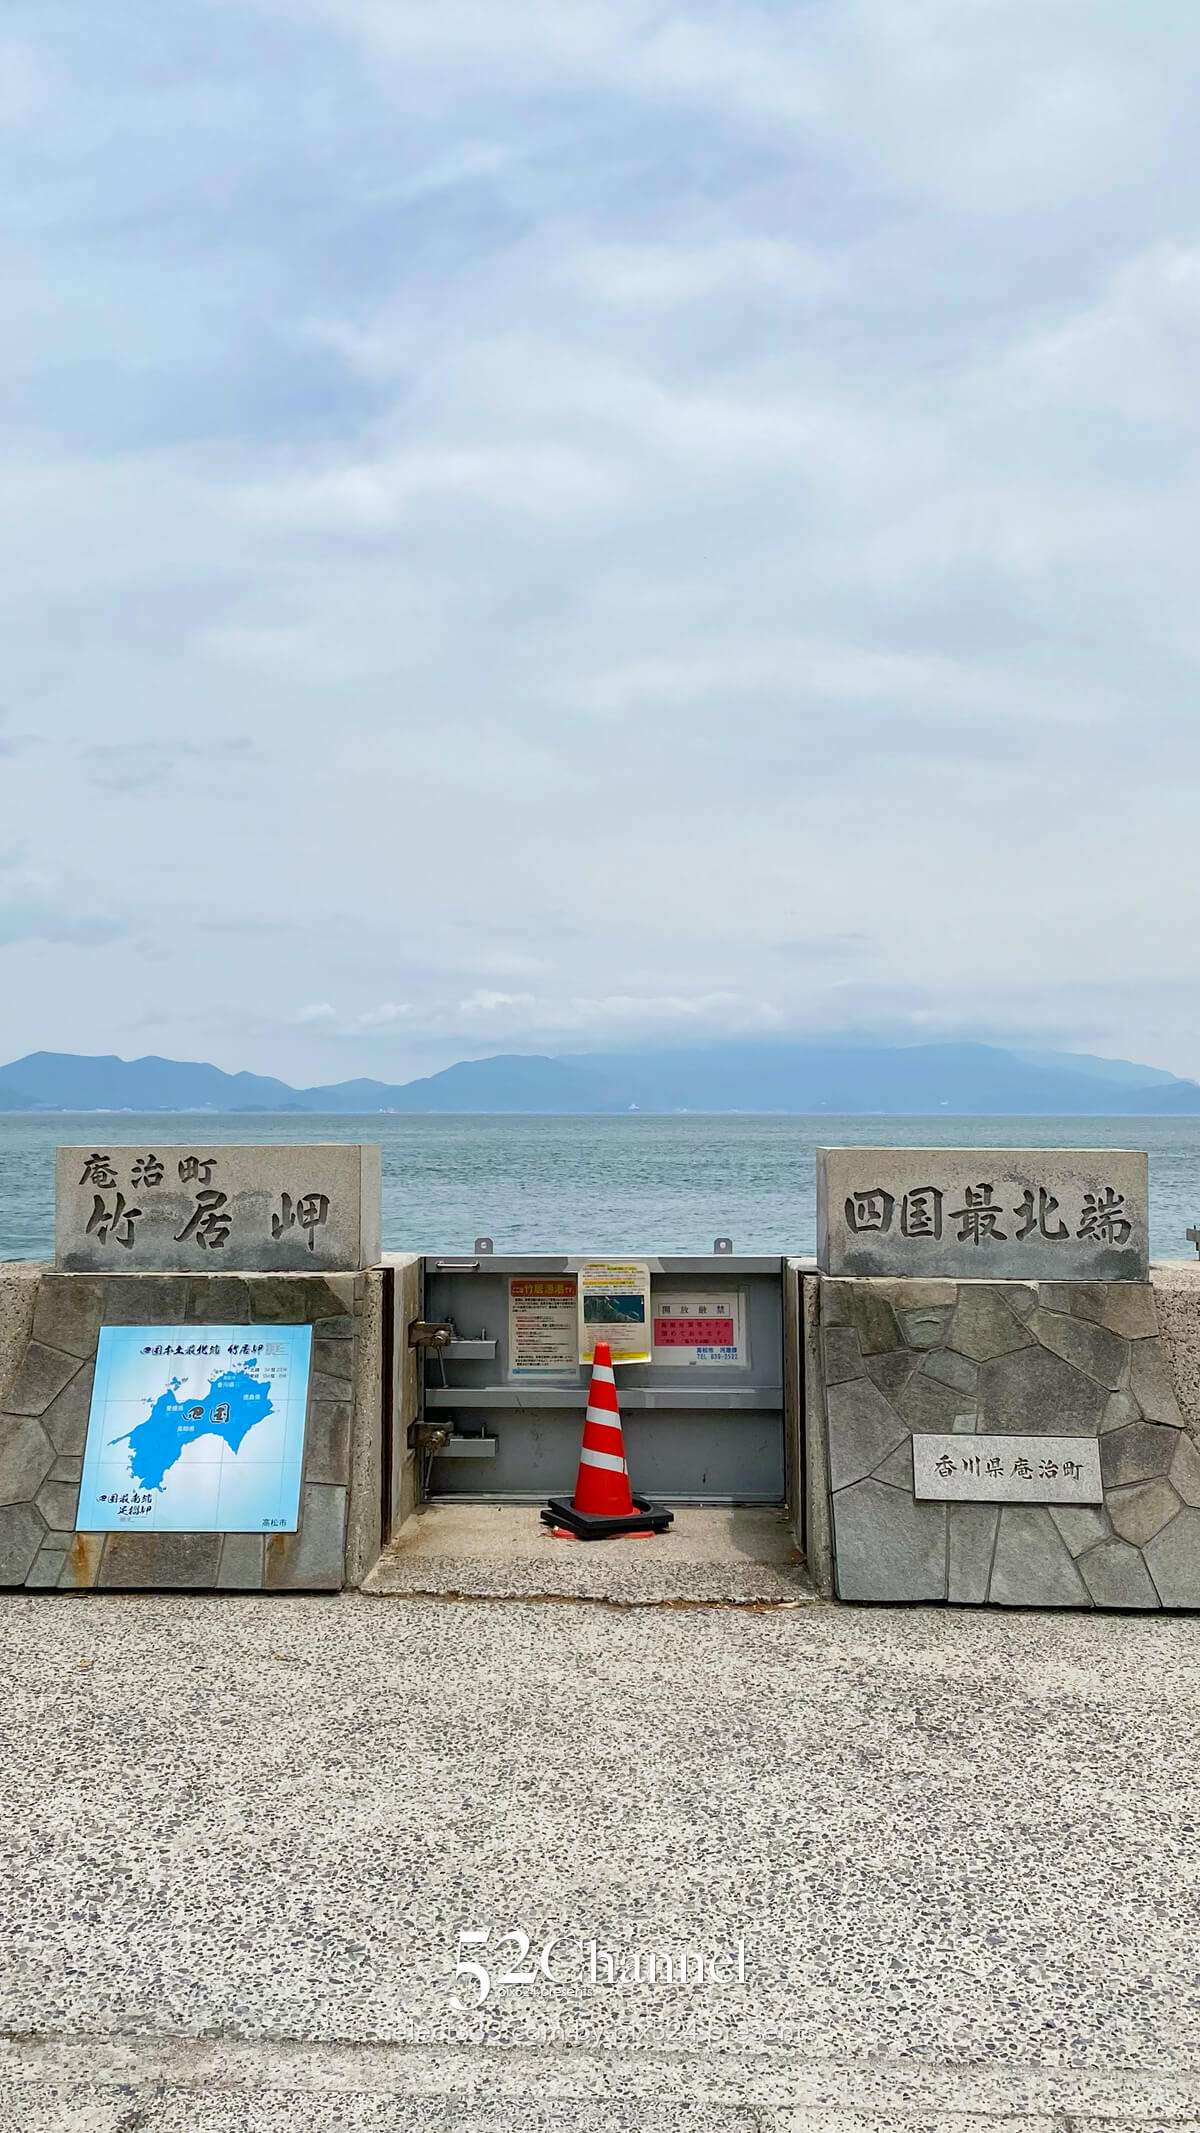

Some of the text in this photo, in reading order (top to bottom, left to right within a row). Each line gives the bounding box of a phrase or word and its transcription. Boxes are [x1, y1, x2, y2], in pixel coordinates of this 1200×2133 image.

[79, 1153, 217, 1189] 庵治町
[86, 1189, 331, 1251] 竹居岬
[845, 1183, 1132, 1246] 四国最北端
[182, 1401, 230, 1424] 四国
[261, 1518, 288, 1528] 高松市
